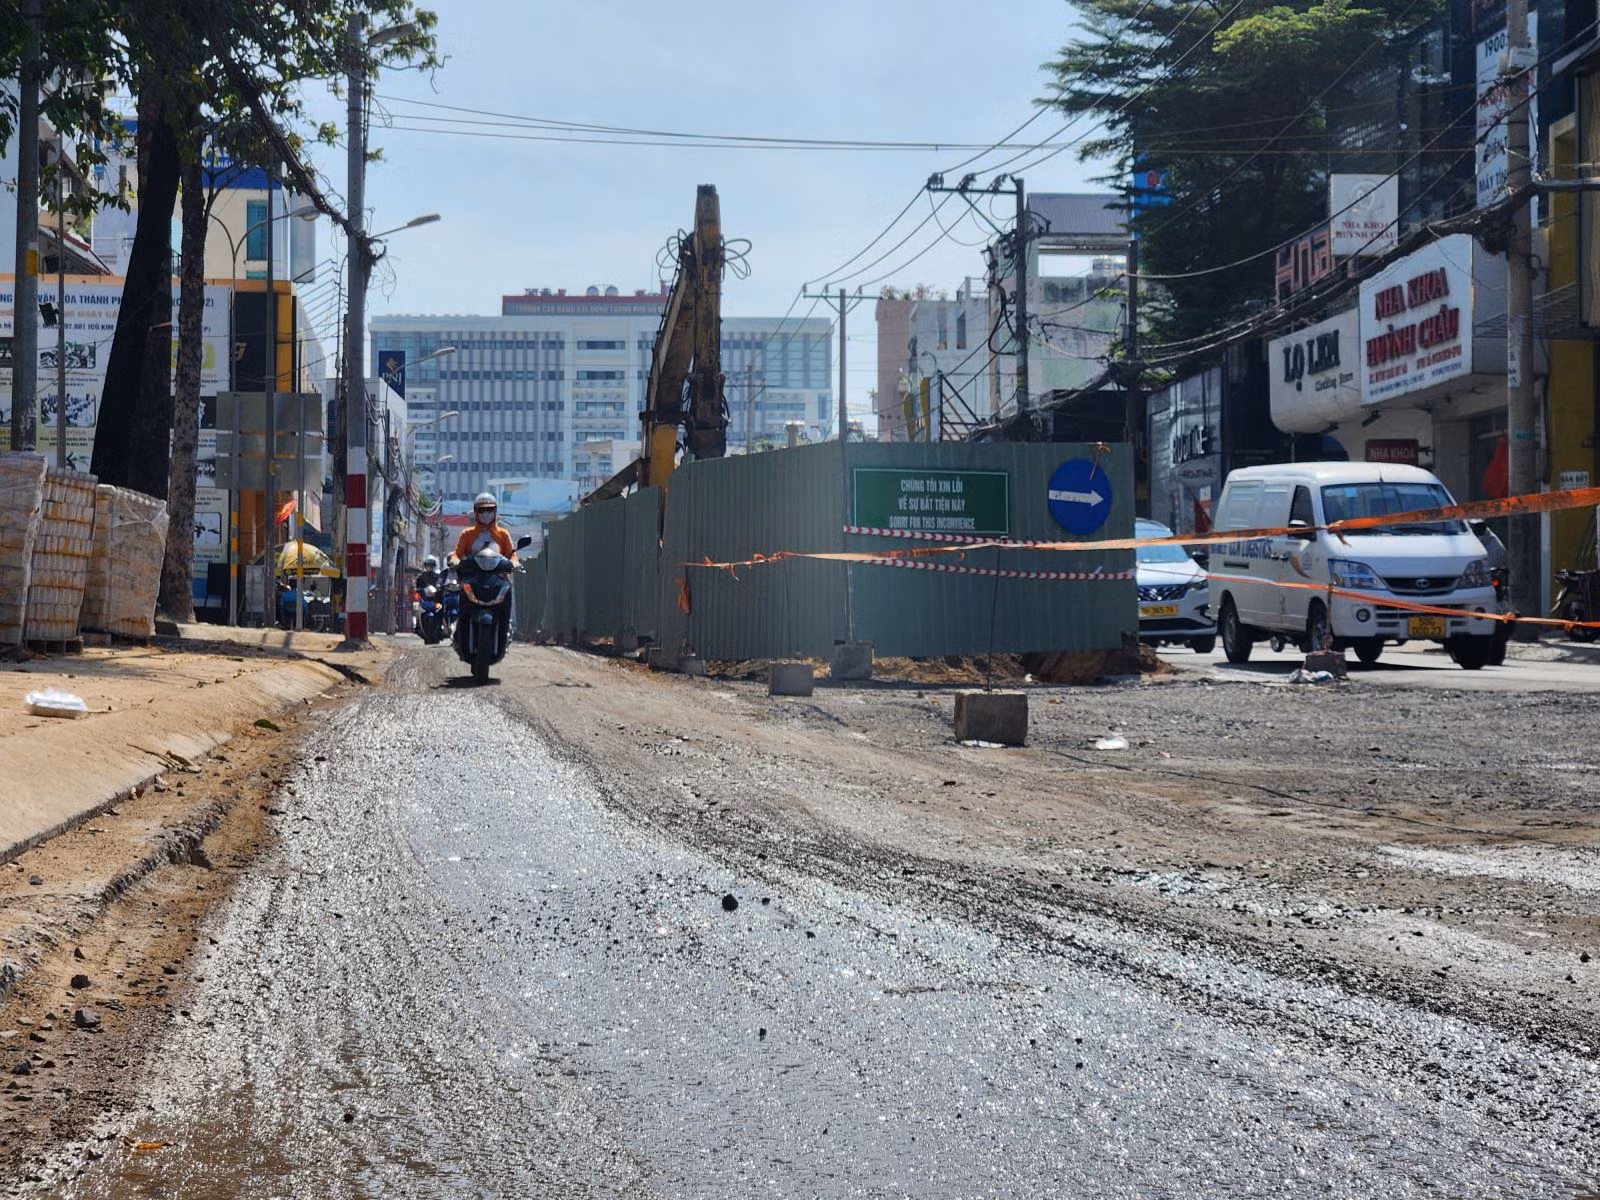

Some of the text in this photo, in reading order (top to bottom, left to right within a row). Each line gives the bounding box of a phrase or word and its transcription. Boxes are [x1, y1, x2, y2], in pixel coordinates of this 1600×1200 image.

[1375, 267, 1450, 320] NHA KHOA
[1417, 304, 1460, 350] CHÂU
[900, 477, 925, 493] CHÚNG
[926, 477, 937, 493] TÔI
[938, 481, 951, 493] XIN
[889, 515, 909, 528] SORRY
[909, 516, 921, 528] FOR
[922, 516, 936, 529] THIS
